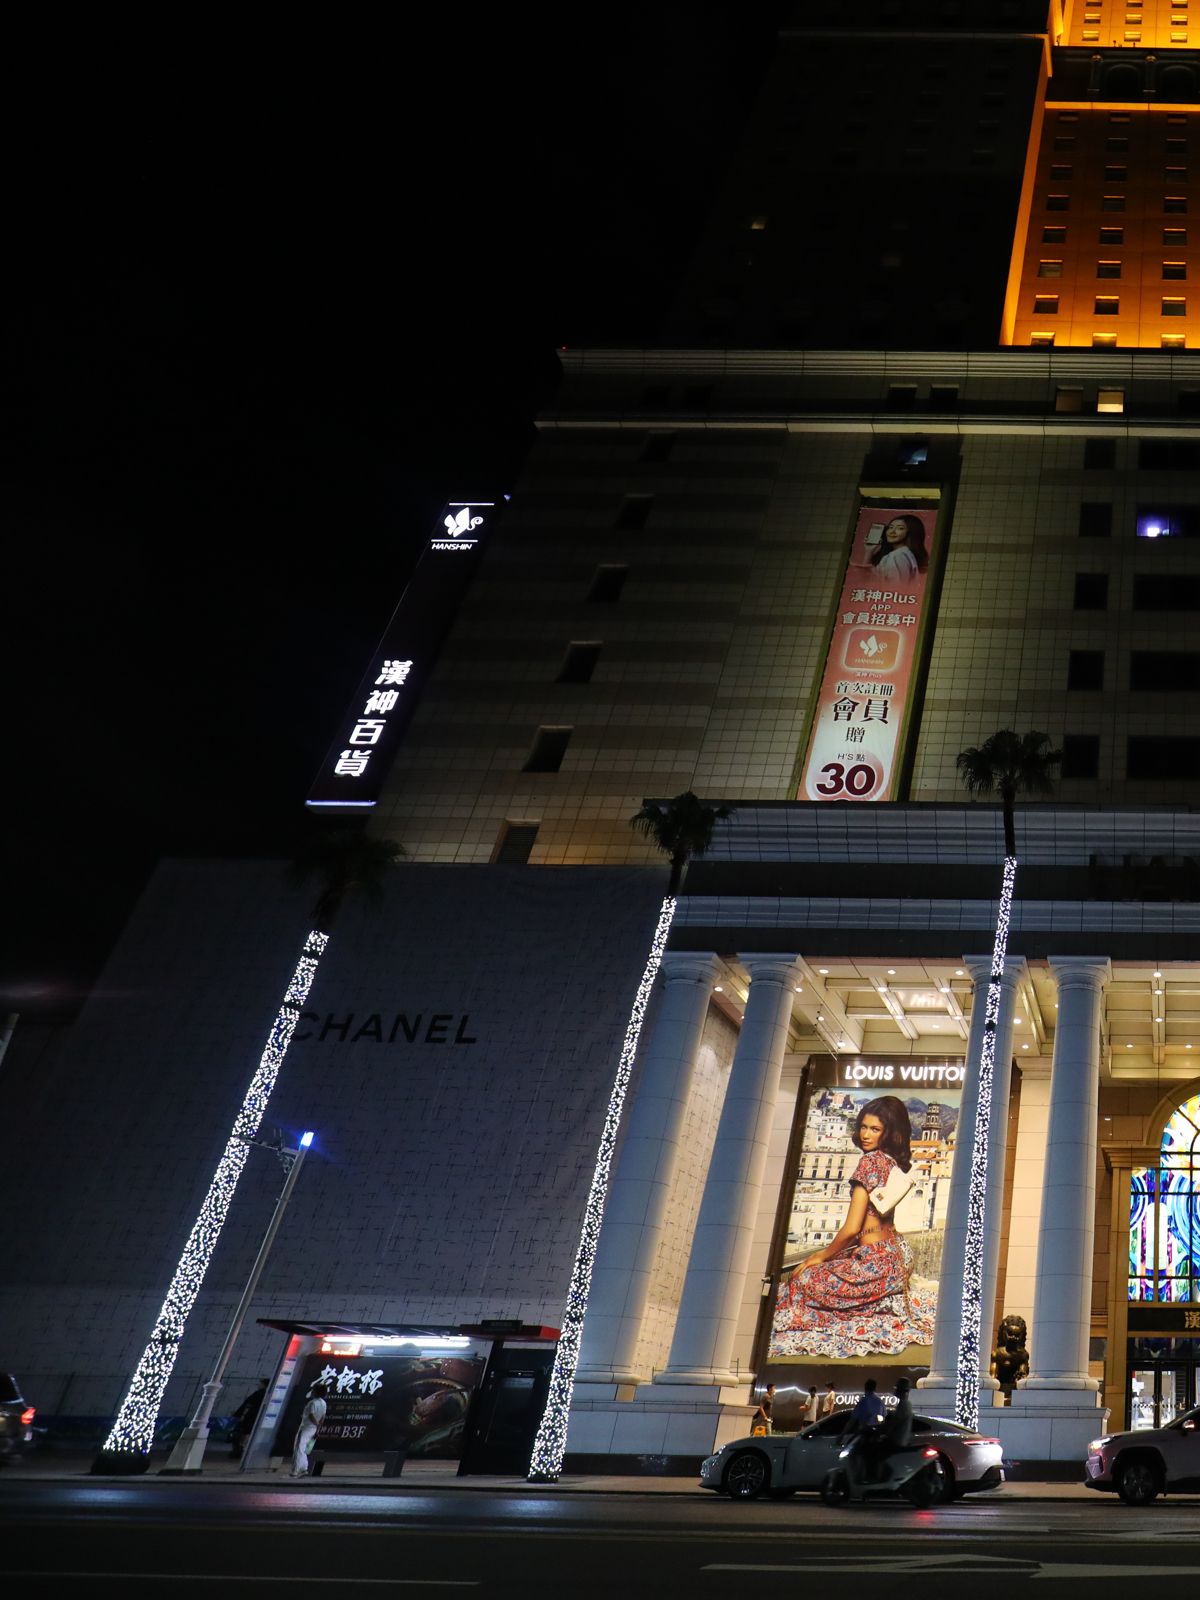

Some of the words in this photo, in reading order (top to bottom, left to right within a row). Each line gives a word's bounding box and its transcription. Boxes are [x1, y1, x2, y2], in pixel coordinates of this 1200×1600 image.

[431, 543, 473, 551] HANSHIN
[850, 589, 917, 605] 漢神Plus
[842, 611, 916, 627] 會員招募中
[836, 682, 894, 697] 首次註冊
[334, 659, 413, 777] 漢神百貨
[832, 696, 890, 724] 會員
[846, 727, 866, 743] 贈
[837, 753, 854, 761] H'S
[816, 762, 876, 796] 30
[292, 1012, 478, 1044] CHANEL
[845, 1065, 894, 1080] LOUIS
[834, 1394, 860, 1404] OUIS
[341, 1426, 366, 1438] B3F
